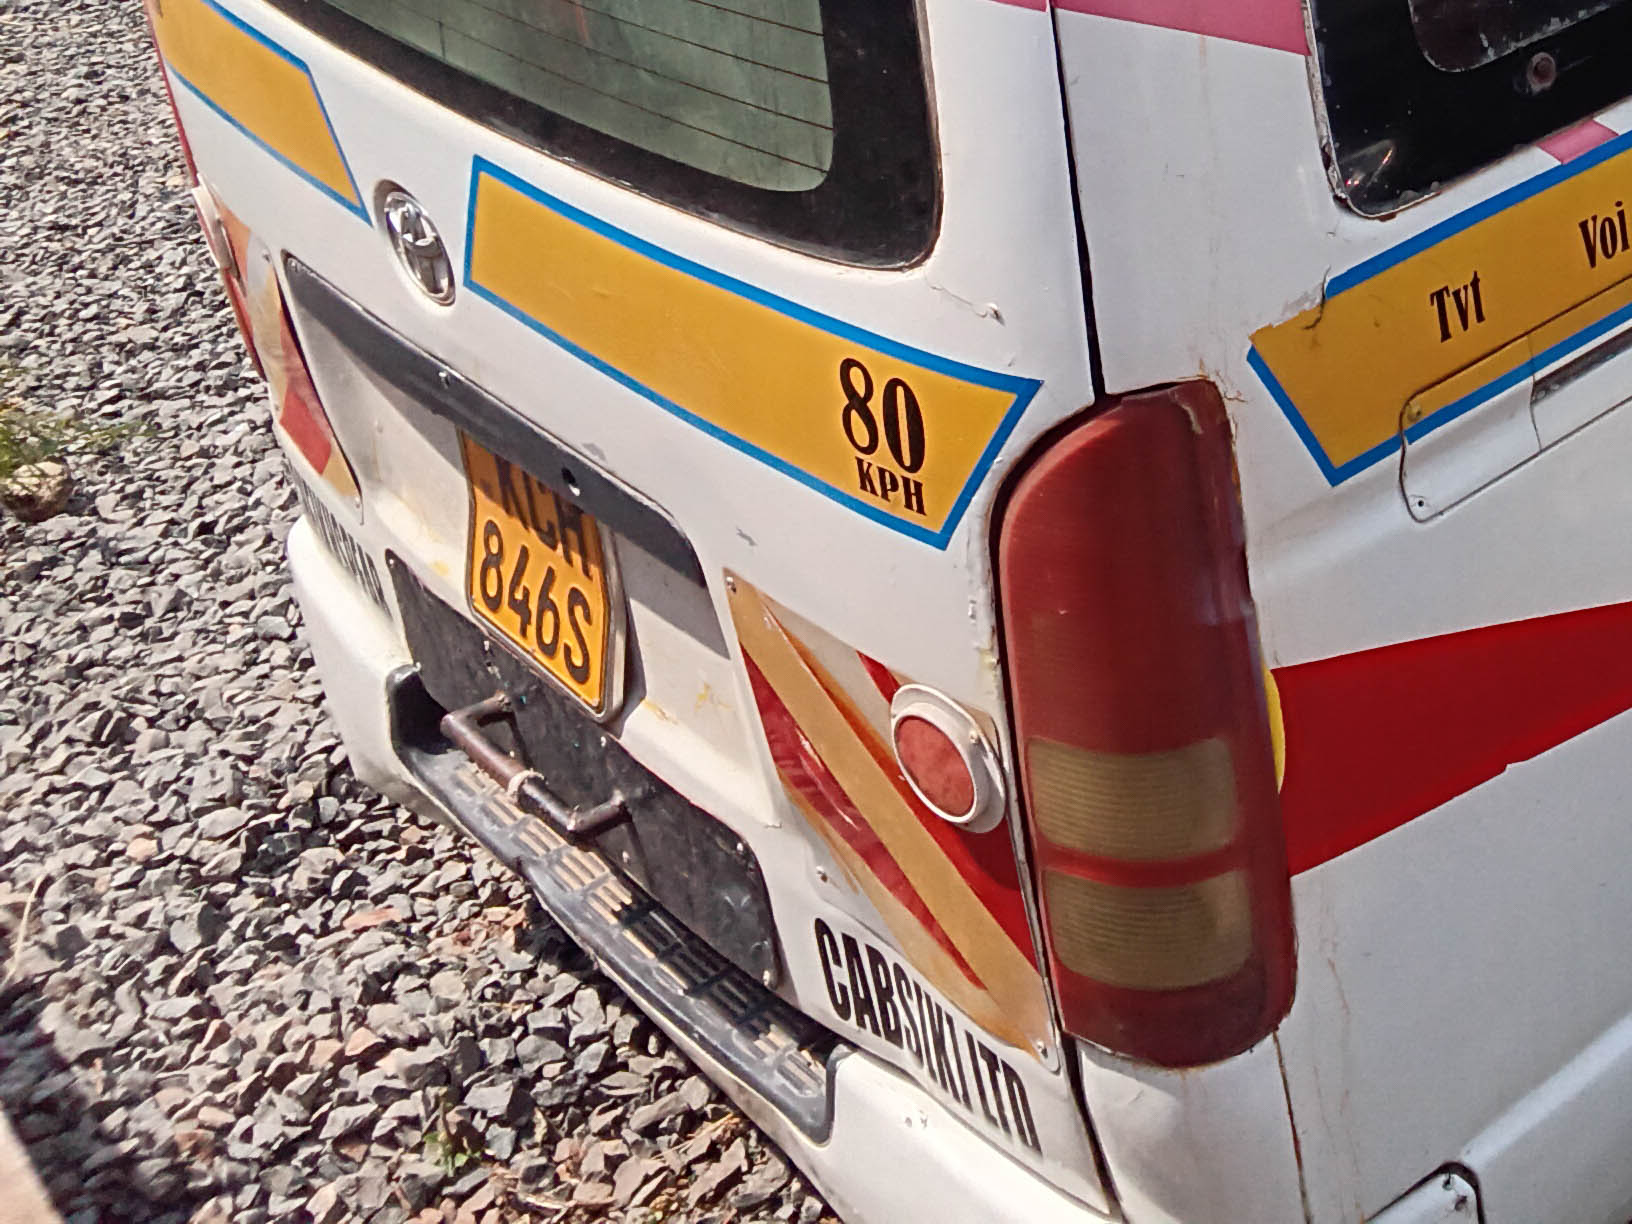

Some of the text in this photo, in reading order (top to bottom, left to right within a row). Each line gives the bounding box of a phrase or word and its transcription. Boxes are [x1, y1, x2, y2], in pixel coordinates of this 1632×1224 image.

[1430, 271, 1486, 343] Tvt
[1579, 201, 1630, 268] Voi
[840, 357, 925, 474] 80
[855, 456, 927, 516] KPH
[480, 520, 592, 684] 846S
[965, 1029, 1043, 1158] LTD
